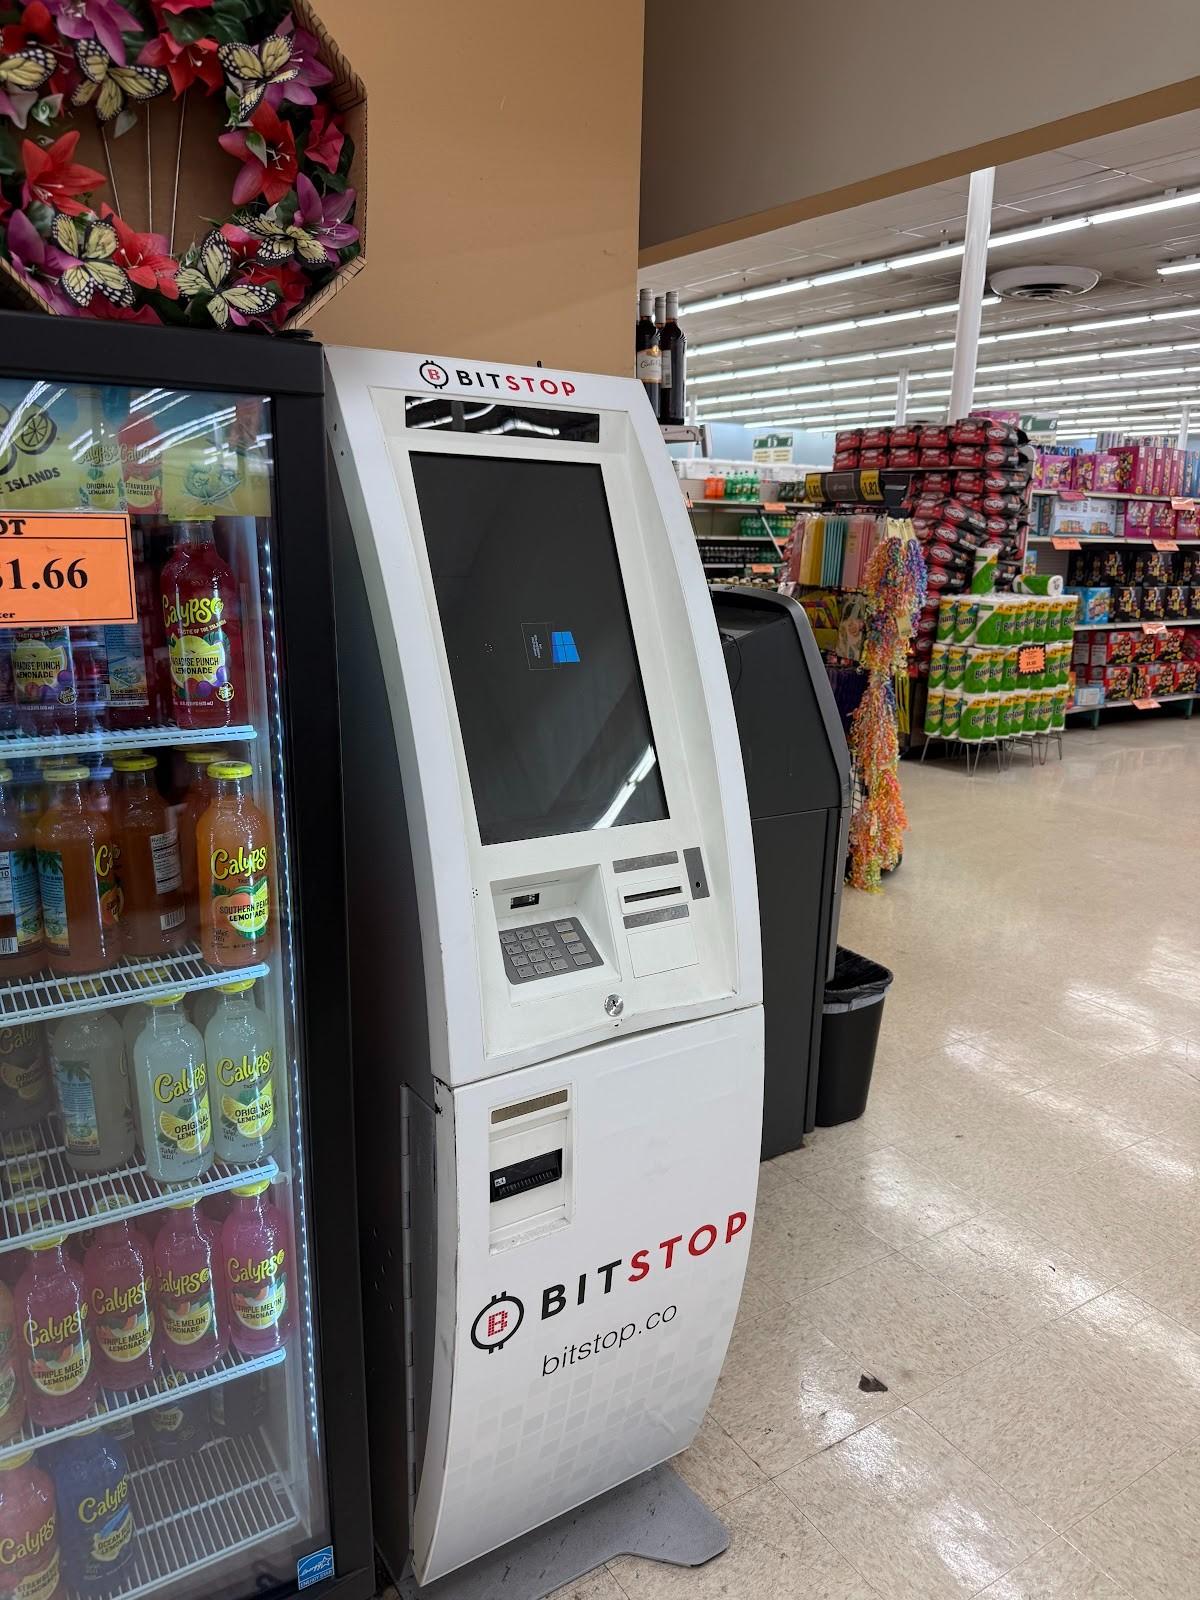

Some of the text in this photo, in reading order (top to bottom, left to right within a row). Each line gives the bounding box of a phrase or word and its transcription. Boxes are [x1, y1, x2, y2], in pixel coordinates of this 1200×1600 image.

[456, 369, 576, 397] BITSTOP
[5, 467, 61, 493] ISLANDS
[0, 557, 89, 591] 1.66
[0, 611, 16, 619] er
[162, 594, 225, 629] Calypso
[37, 660, 61, 671] PUNCH
[175, 666, 213, 675] LEMONADE
[195, 657, 219, 667] PUNCH
[210, 846, 268, 880] Calyps
[219, 903, 255, 915] SOUTHERN
[154, 1062, 207, 1104] Calyps
[215, 1048, 273, 1088] Calyps
[177, 1122, 209, 1141] LEMOADE
[228, 1249, 285, 1284] Calypso
[541, 1211, 748, 1320] BITSTOP
[92, 1276, 153, 1315] Calypso
[23, 1301, 89, 1347] Calypso
[181, 1315, 206, 1327] MELON
[242, 1309, 276, 1319] LEMONAD
[542, 1304, 677, 1377] bitstop.co
[79, 1477, 129, 1523] Calyps
[0, 1513, 56, 1564] Calyps
